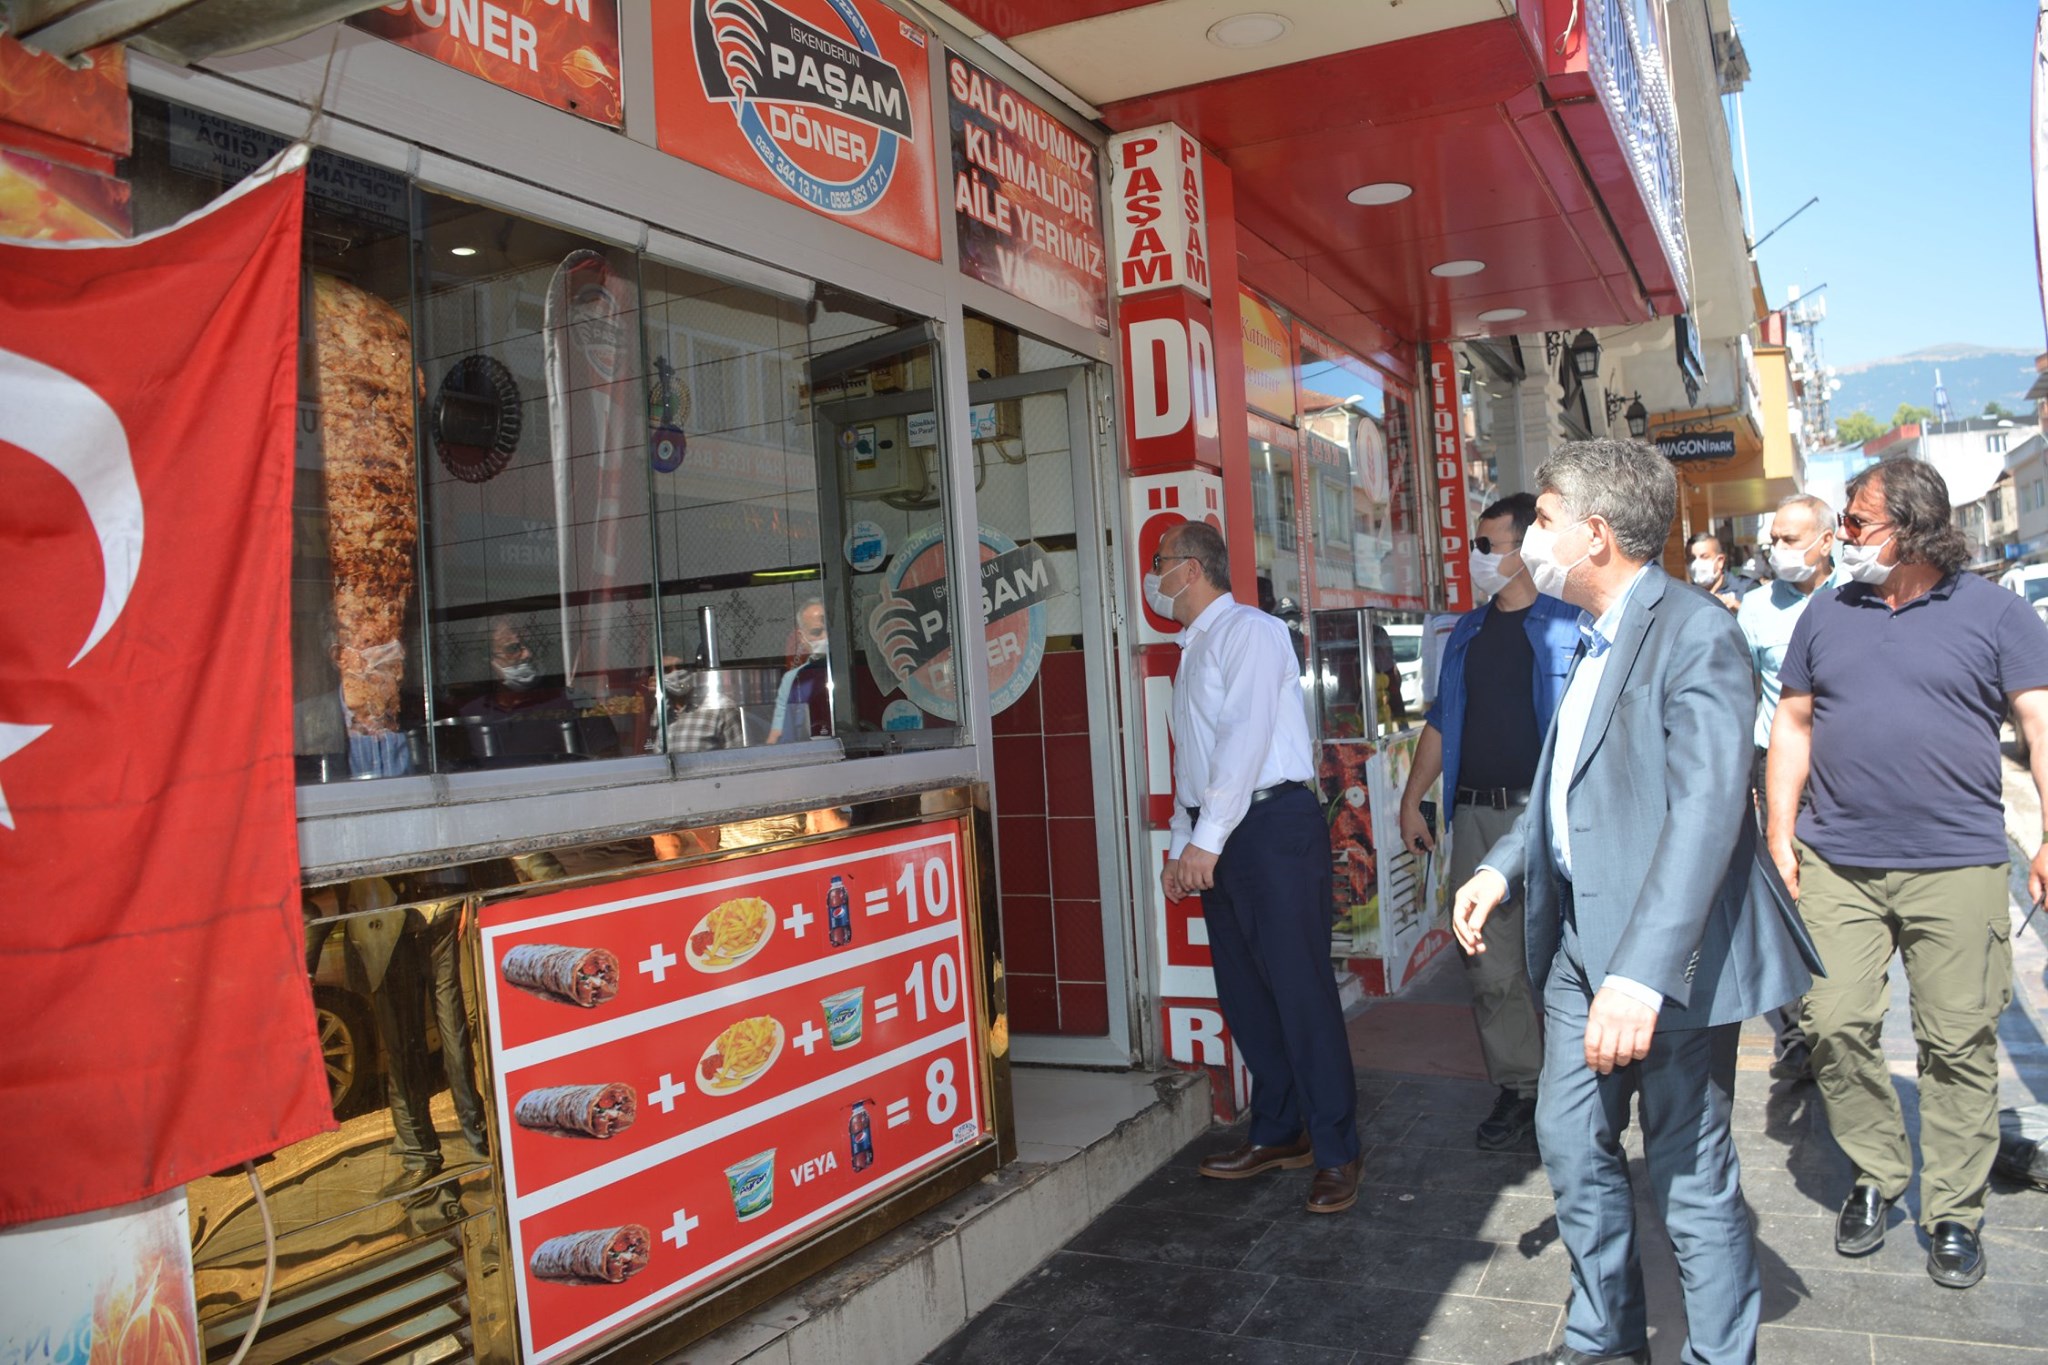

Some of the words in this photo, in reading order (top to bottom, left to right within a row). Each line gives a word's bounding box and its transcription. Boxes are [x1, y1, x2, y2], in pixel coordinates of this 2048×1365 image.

[770, 42, 902, 121] PAŞAM
[790, 23, 860, 69] İSKENDERUN
[769, 105, 867, 166] DÖNER
[951, 59, 1093, 180] SALONUMUZ
[799, 176, 810, 198] 13
[812, 185, 823, 205] 71
[875, 163, 888, 186] 71
[965, 122, 1094, 228] KLİMALIDIR
[1121, 138, 1174, 289] PAŞAM
[1180, 135, 1208, 288] PAŞAM
[956, 168, 1013, 235] AİLE
[1016, 203, 1103, 280] YERİMİZ
[790, 1151, 837, 1187] VEYA
